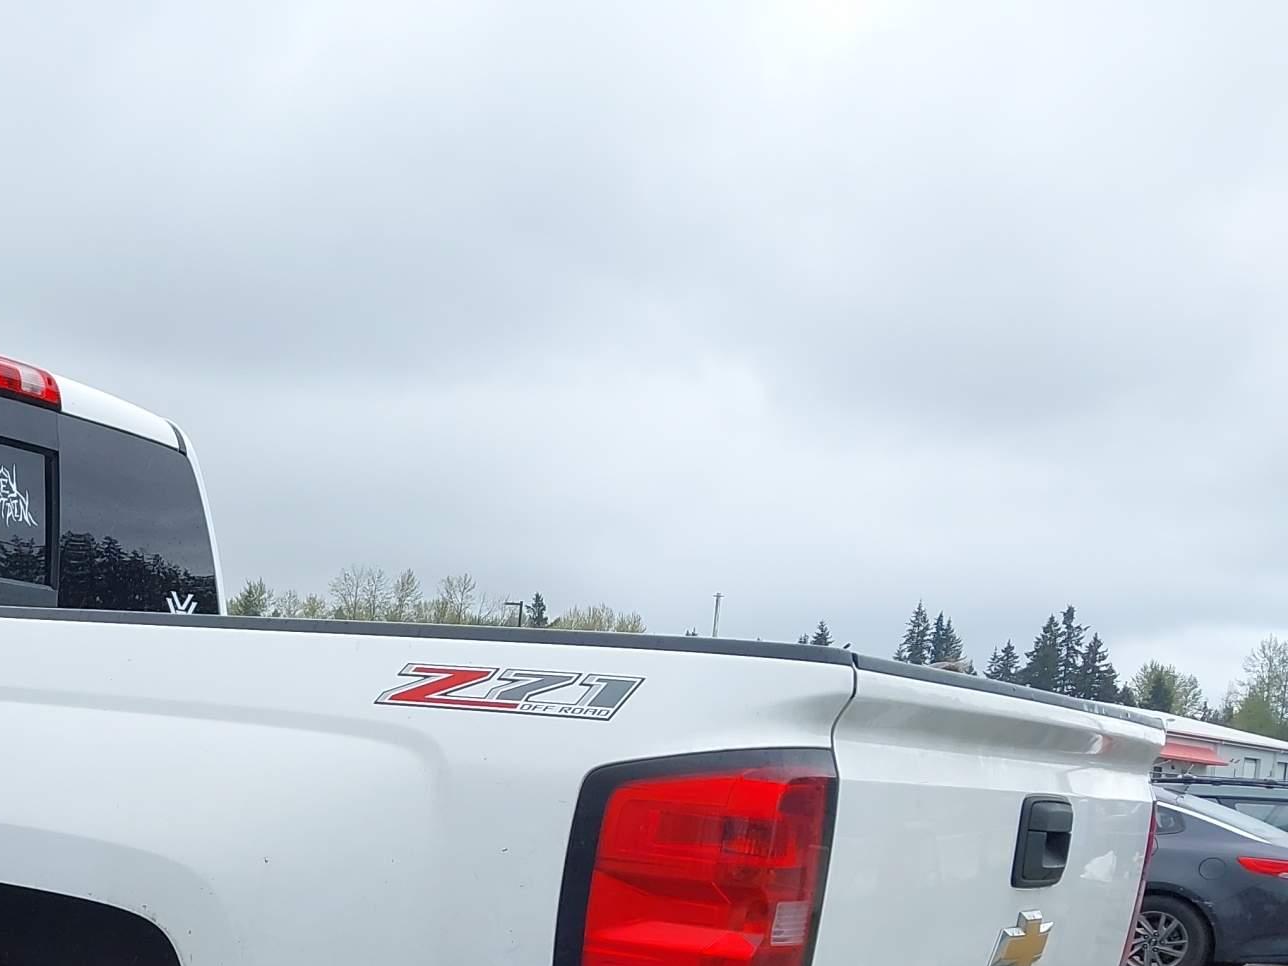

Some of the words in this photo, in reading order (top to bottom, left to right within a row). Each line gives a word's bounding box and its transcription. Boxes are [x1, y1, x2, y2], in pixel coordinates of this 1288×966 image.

[373, 662, 646, 721] Z71
[519, 703, 556, 712] OFF
[558, 706, 611, 717] ROAD
